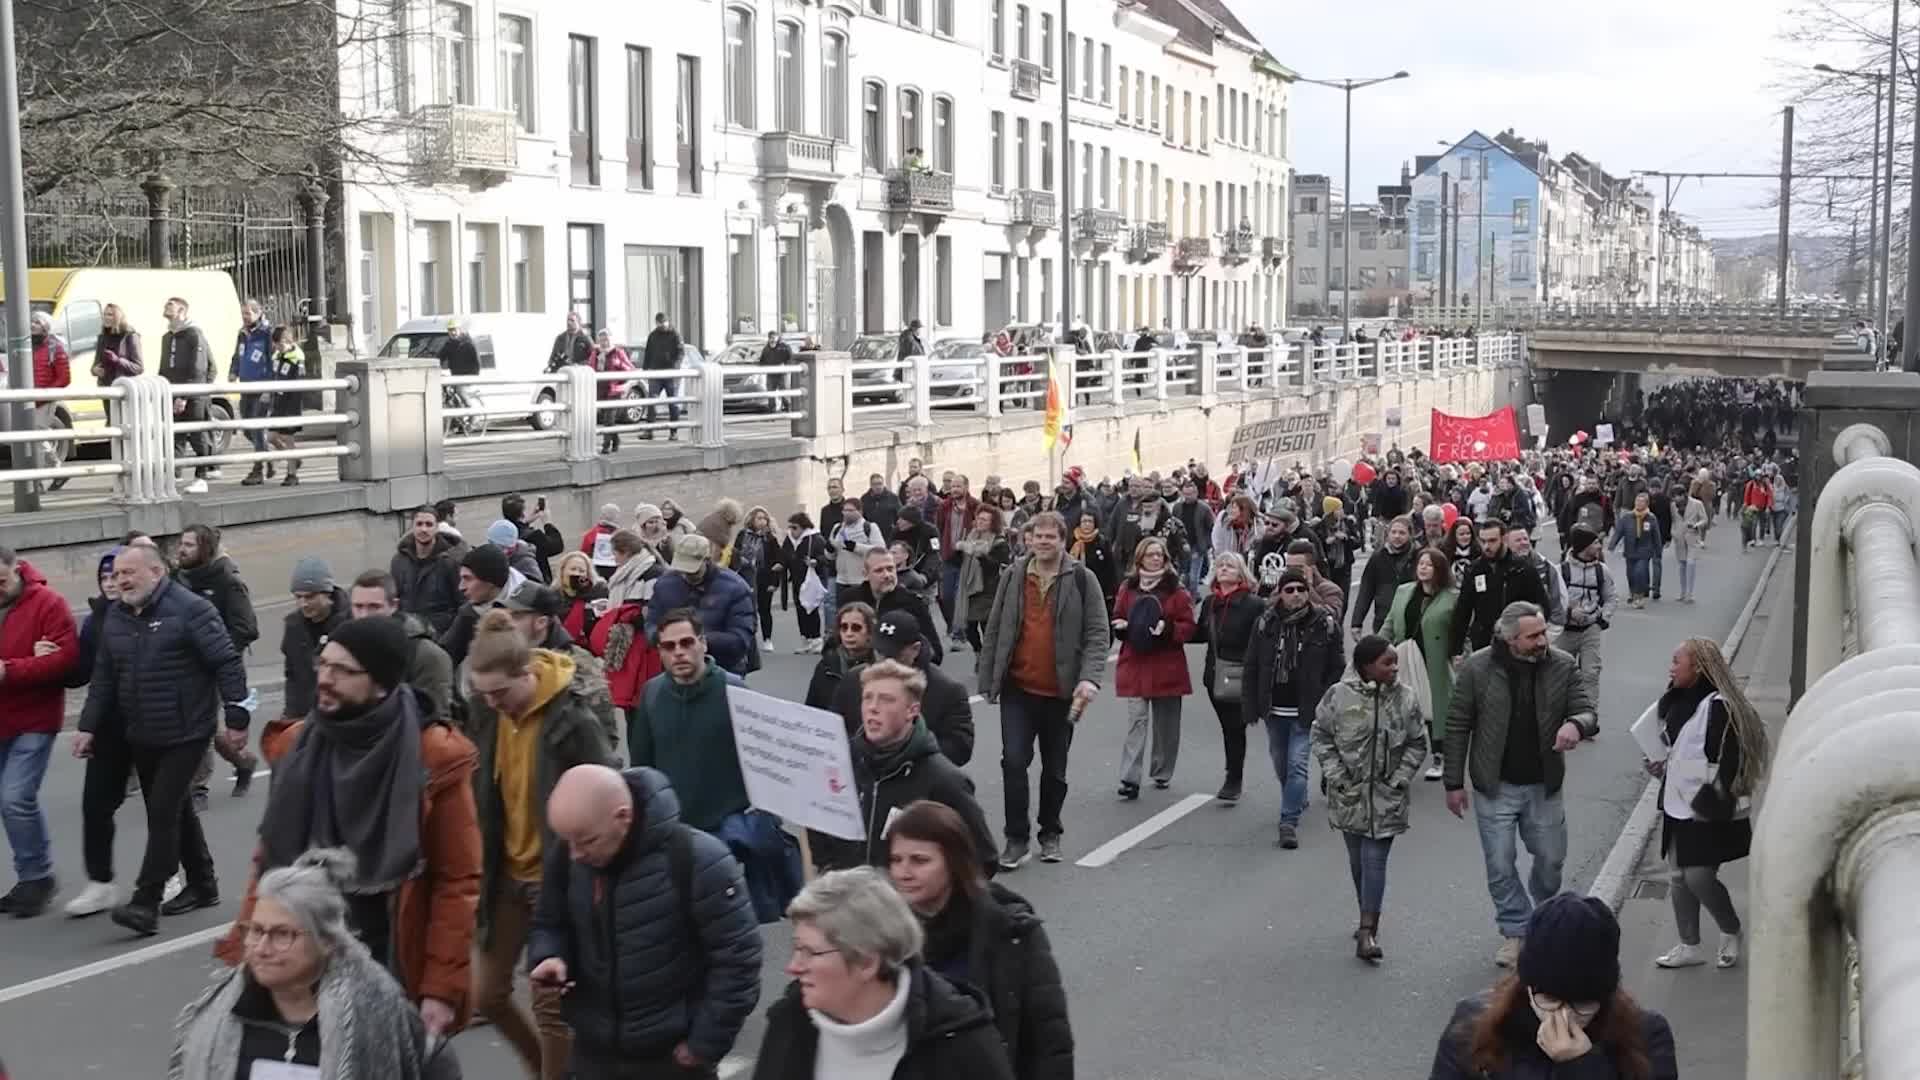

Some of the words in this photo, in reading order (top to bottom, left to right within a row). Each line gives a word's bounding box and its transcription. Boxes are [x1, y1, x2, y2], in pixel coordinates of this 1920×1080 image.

[1233, 426, 1252, 444] LES
[1252, 413, 1328, 439] COMPLOTISTES
[1254, 433, 1316, 457] RAISON
[1437, 442, 1519, 460] FREEDOM
